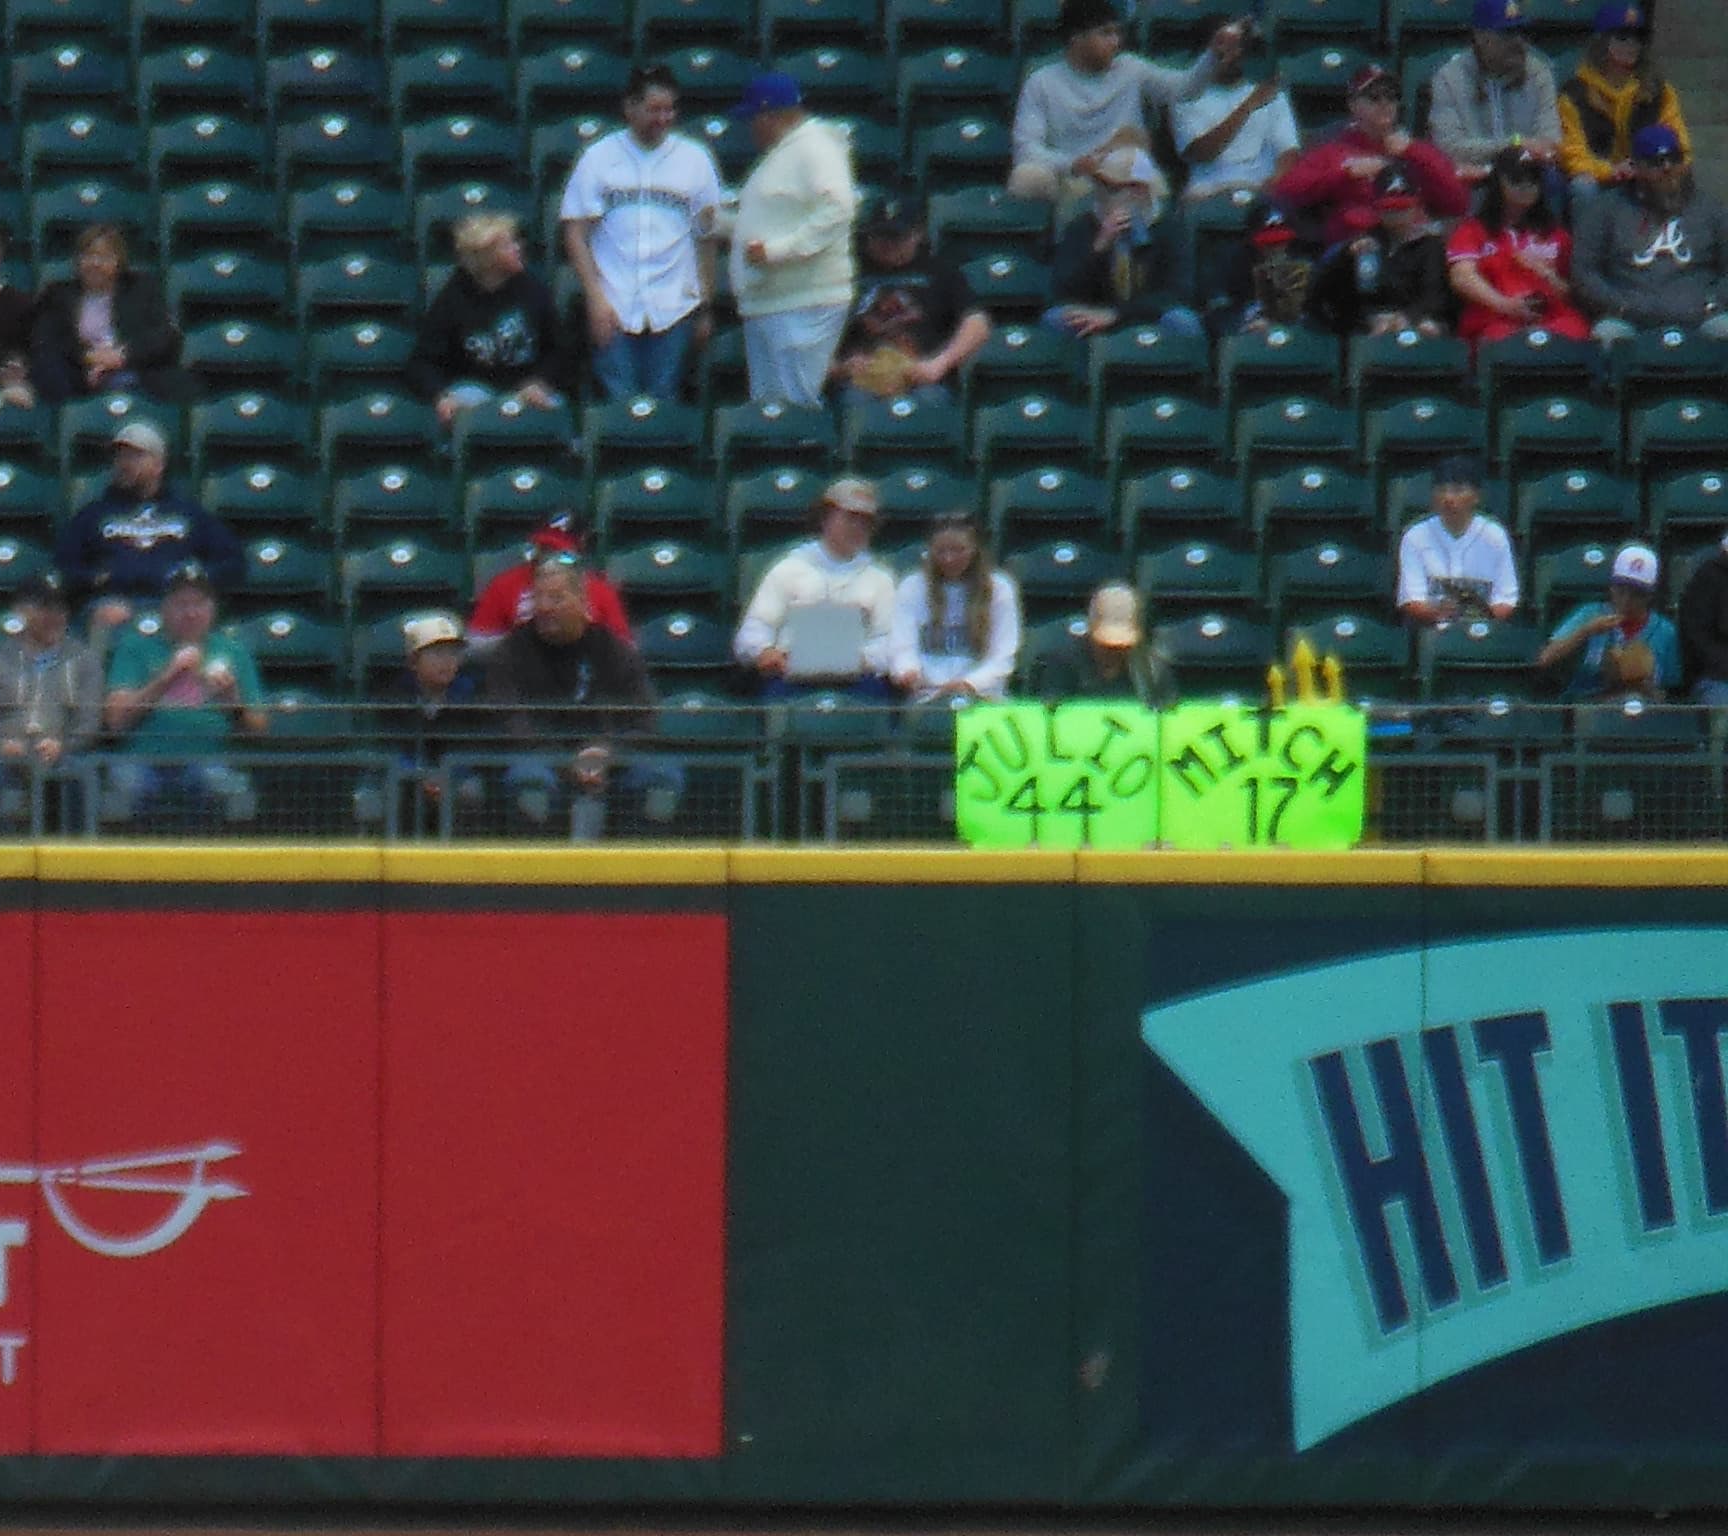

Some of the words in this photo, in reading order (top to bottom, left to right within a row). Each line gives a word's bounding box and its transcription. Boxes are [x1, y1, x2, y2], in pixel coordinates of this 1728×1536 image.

[959, 703, 1153, 800] JULIO
[1171, 708, 1357, 799] MITCH
[1003, 776, 1102, 848] 44
[1242, 776, 1299, 845] 17
[1306, 1008, 1572, 1336] HIT
